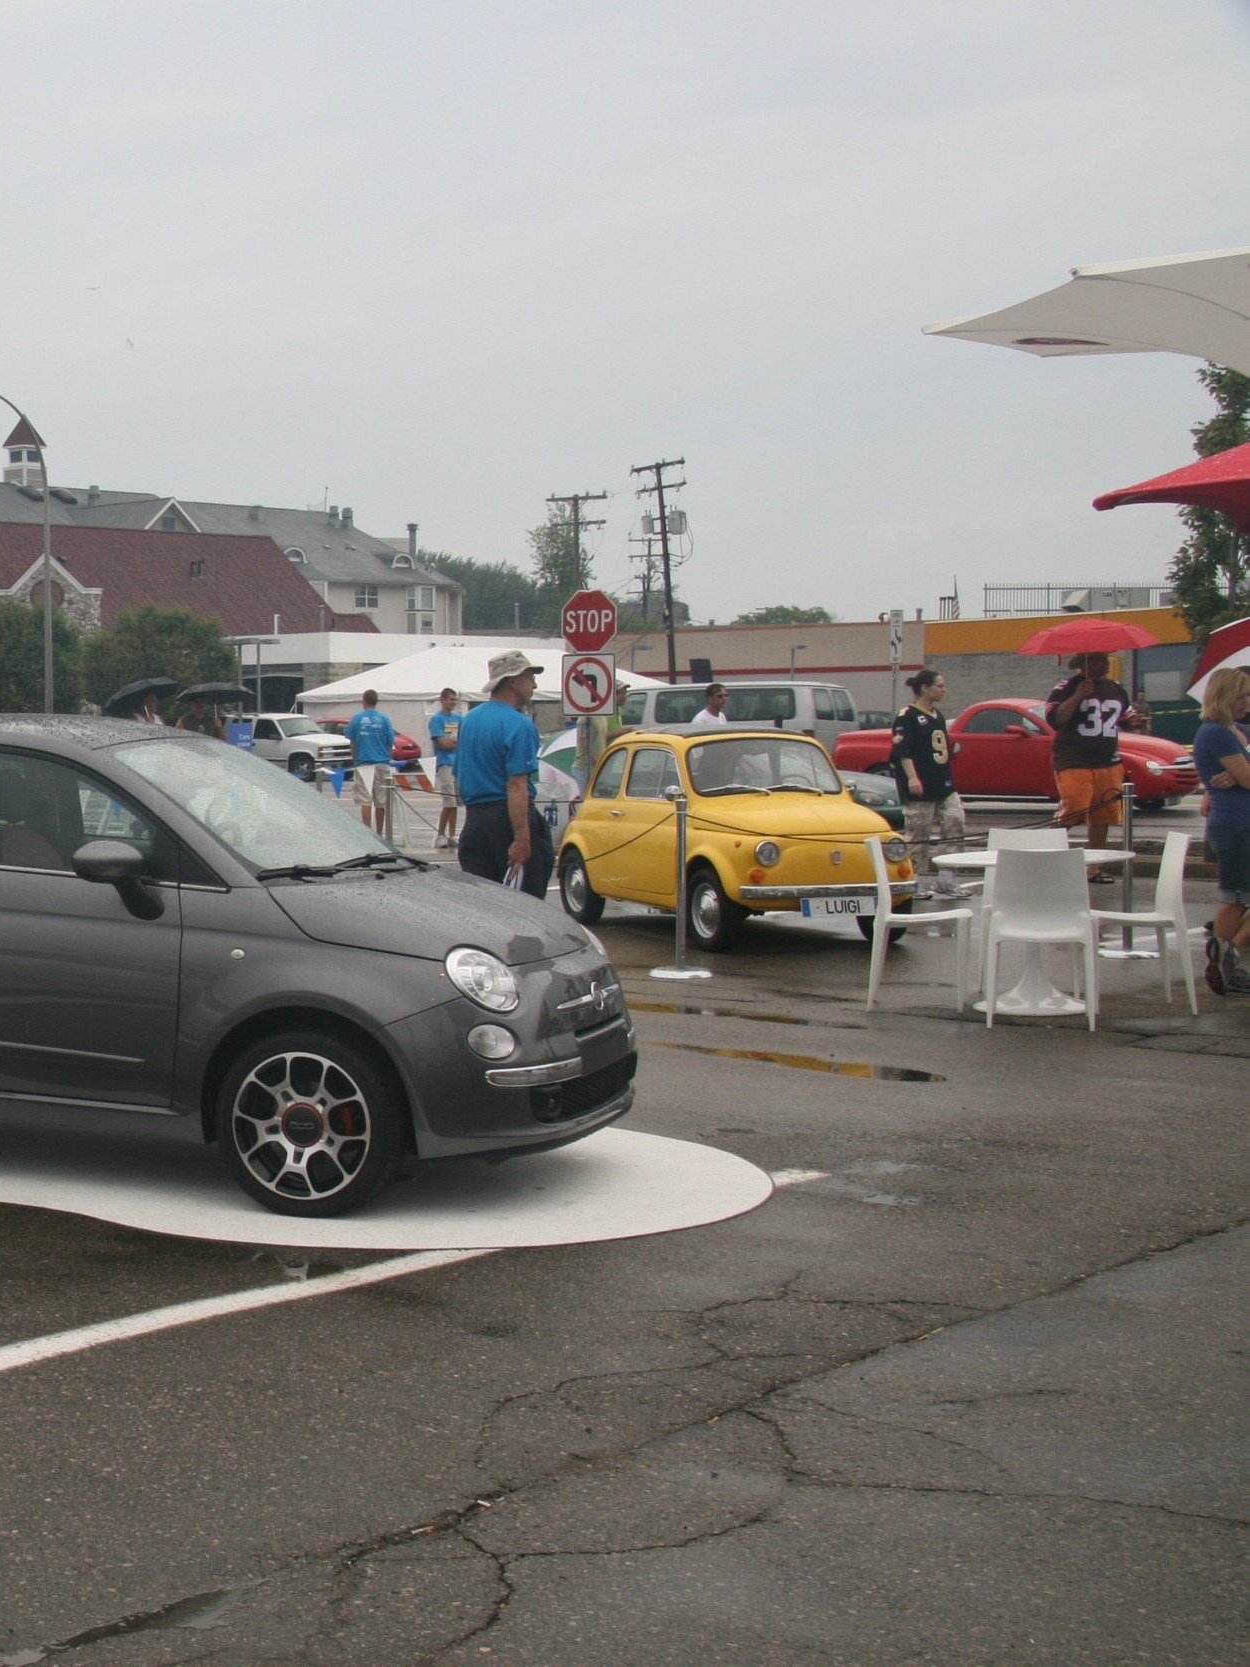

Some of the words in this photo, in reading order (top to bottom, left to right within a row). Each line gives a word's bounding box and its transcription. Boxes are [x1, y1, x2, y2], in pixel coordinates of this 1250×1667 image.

[565, 609, 613, 633] STOP
[1077, 698, 1122, 737] 32
[931, 729, 949, 764] 9
[825, 899, 861, 914] LUIGI
